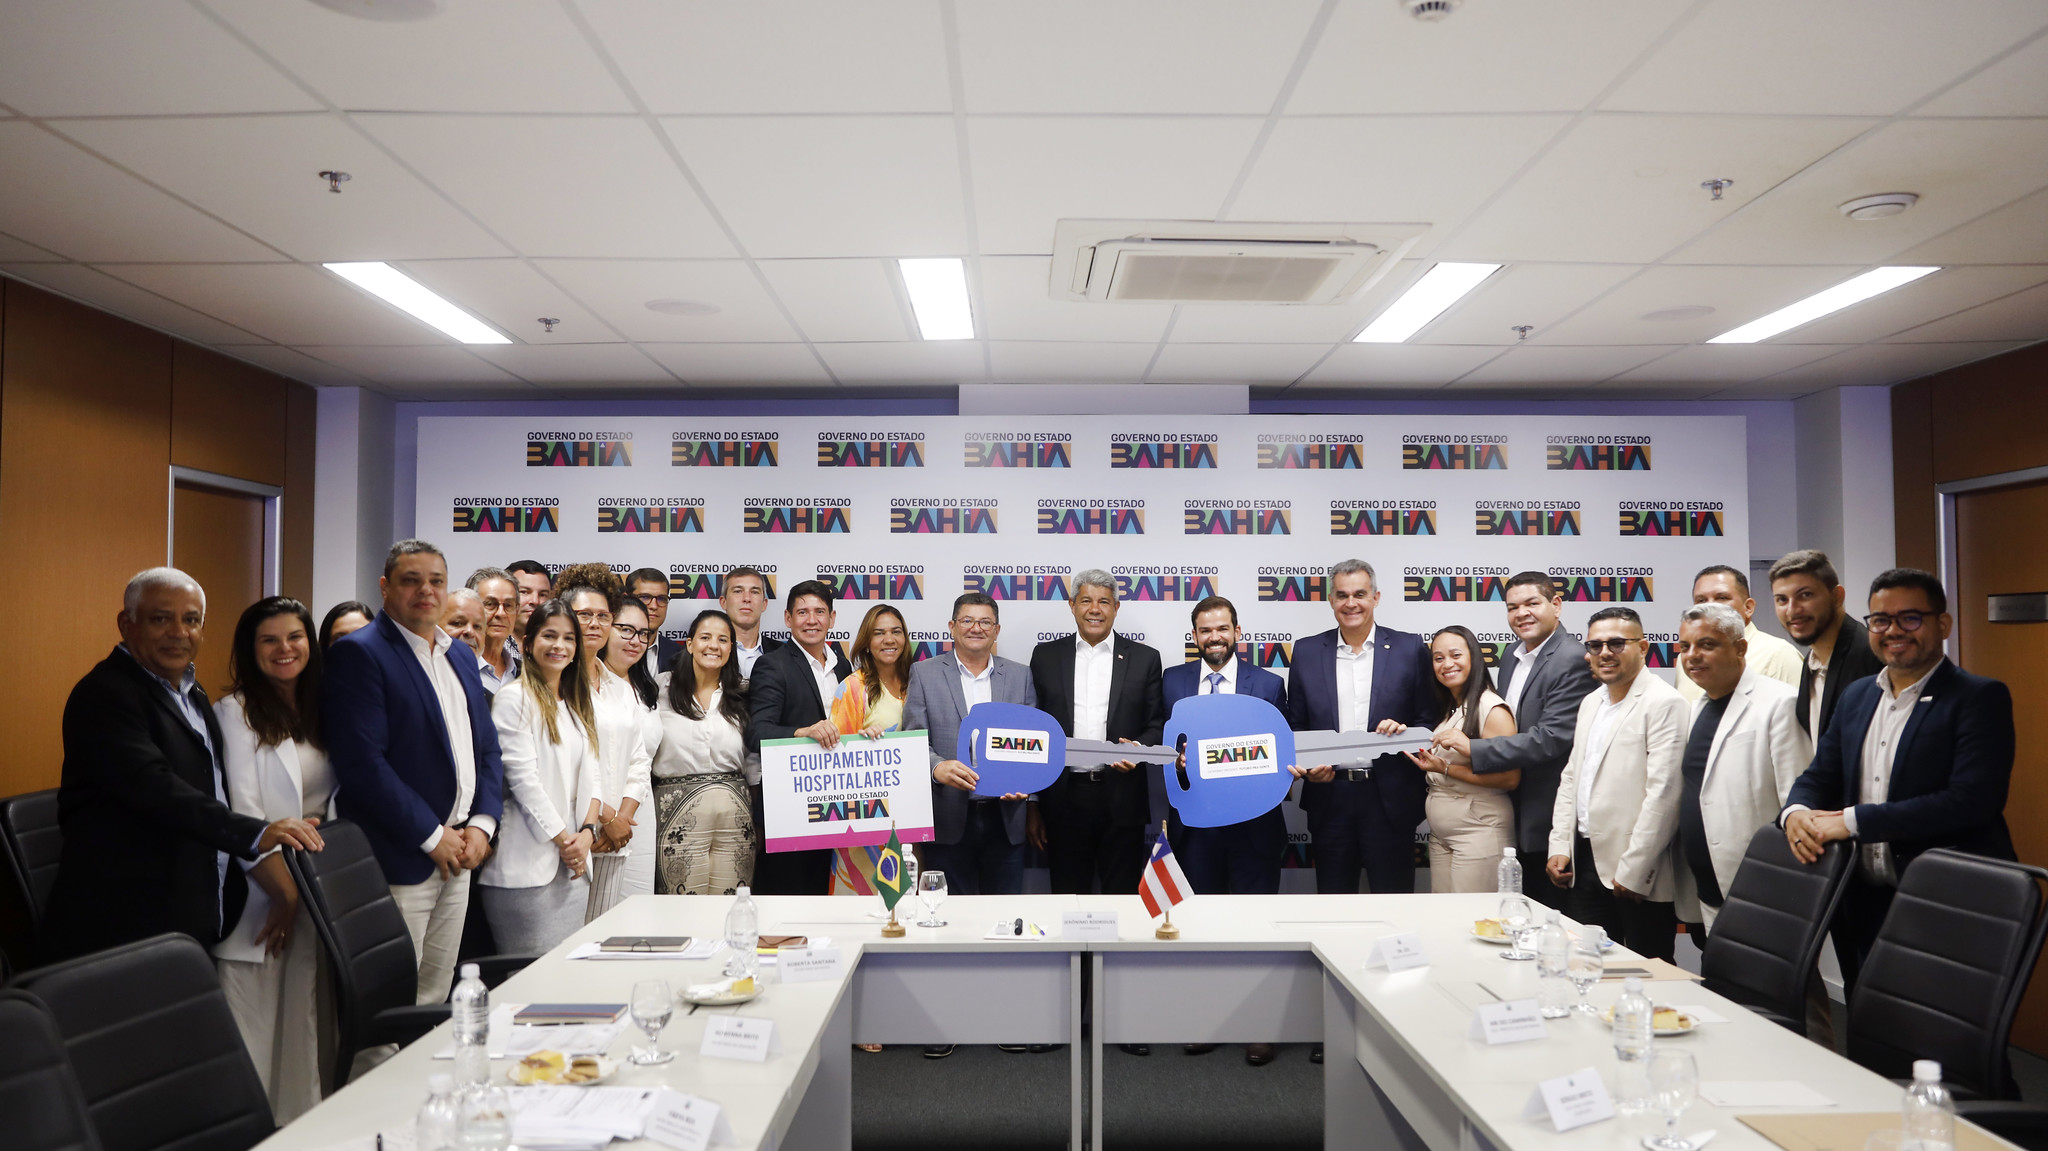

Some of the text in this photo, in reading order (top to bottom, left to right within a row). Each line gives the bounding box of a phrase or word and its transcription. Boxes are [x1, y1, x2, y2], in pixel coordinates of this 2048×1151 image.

[527, 432, 632, 440] GOVERNO DO ESTADO
[672, 432, 778, 440] GOVERNO DO ESTADO
[818, 432, 925, 440] GOVERNO DO ESTADO
[964, 433, 1071, 441] GOVERNO DO ESTADO
[1111, 434, 1218, 442] GOVERNO DO ESTADO
[1257, 435, 1363, 443] GOVERNO DO ESTADO
[1402, 435, 1507, 443] GOVERNO DO ESTADO
[1546, 436, 1651, 444] GOVERNO DO ESTADO
[527, 442, 632, 466] BAHIA
[672, 442, 778, 466] BAHIA
[818, 442, 924, 467] BAHIA
[964, 443, 1071, 468] BAHIA
[1111, 443, 1217, 468] BAHIA
[1257, 444, 1363, 469] BAHIA
[1403, 444, 1507, 469] BAHIA
[1547, 445, 1651, 470] BAHIA
[453, 498, 559, 506] GOVERNO DO ESTADO
[598, 498, 704, 506] GOVERNO DO ESTADO
[744, 498, 851, 506] GOVERNO DO ESTADO
[891, 499, 998, 507] GOVERNO DO ESTADO
[1038, 499, 1145, 507] GOVERNO DO ESTADO
[1185, 500, 1291, 508] GOVERNO DO ESTADO
[1331, 501, 1436, 509] GOVERNO DO ESTADO
[1475, 501, 1580, 509] GOVERNO DO ESTADO
[1619, 502, 1723, 510] GOVERNO DO ESTADO
[453, 507, 558, 532] BAHIA
[598, 508, 704, 532] BAHIA
[744, 508, 850, 533] BAHIA
[890, 508, 997, 533] BAHIA
[1037, 509, 1144, 534] BAHIA
[1185, 510, 1290, 535] BAHIA
[1331, 510, 1436, 535] BAHIA
[1476, 510, 1580, 535] BAHIA
[1619, 511, 1723, 536] BAHIA
[670, 565, 719, 573] GOVERNO
[722, 565, 736, 573] DO
[817, 565, 924, 573] GOVERNO DO ESTADO
[963, 566, 1071, 574] GOVERNO DO ESTADO
[1111, 566, 1218, 574] GOVERNO DO ESTADO
[1258, 567, 1307, 575] GOVERNO
[1310, 567, 1324, 575] DO
[1404, 567, 1509, 575] GOVERNO DO ESTADO
[1548, 567, 1653, 575] GOVERNO DO ESTADO
[1254, 633, 1292, 641] ESTADO
[1477, 633, 1518, 641] GOVERN
[992, 737, 1043, 751] BAHIA
[1207, 746, 1268, 764] BAHIA
[790, 748, 902, 772] EQUIPAMENTOS
[794, 770, 901, 793] HOSPITALARES
[807, 794, 845, 803] GOVERNO
[860, 791, 889, 799] ESTADO
[808, 799, 889, 823] BAHIA
